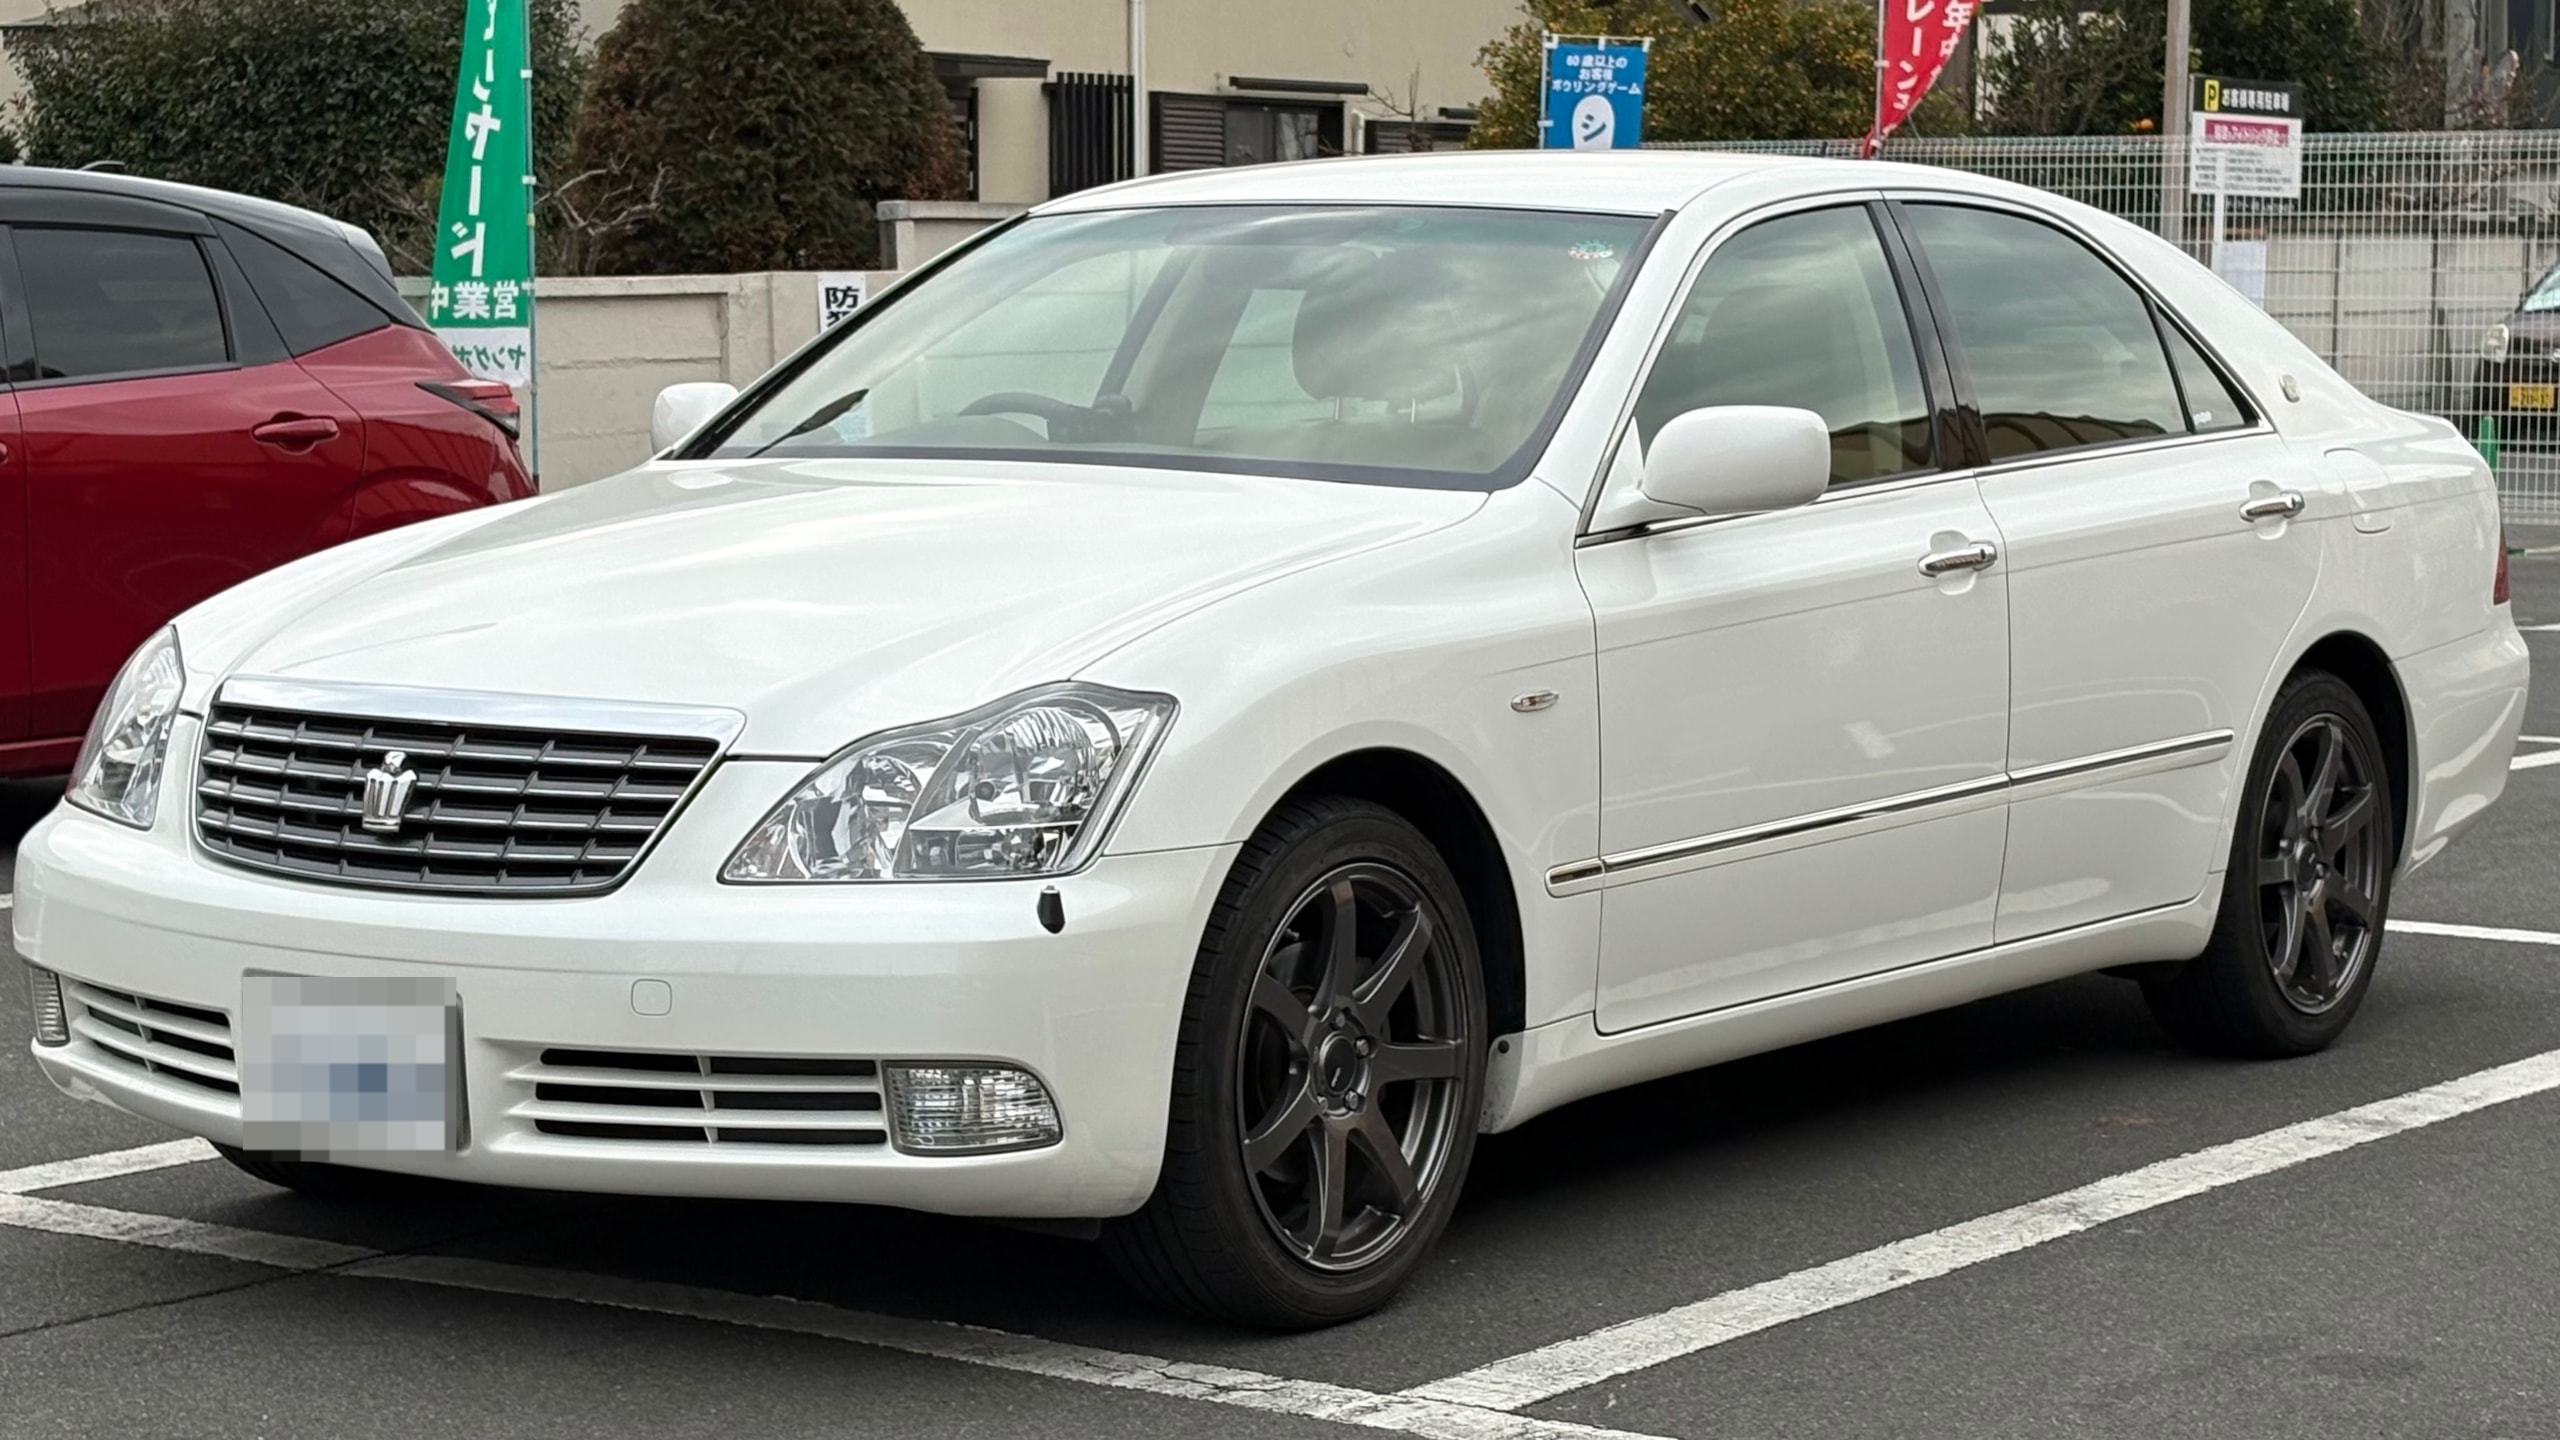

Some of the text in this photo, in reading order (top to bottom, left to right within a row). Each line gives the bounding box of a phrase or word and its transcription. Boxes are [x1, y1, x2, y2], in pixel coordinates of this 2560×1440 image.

[1578, 68, 1613, 81] お客様
[1552, 79, 1642, 95] ボウリングゲーム
[2208, 84, 2217, 109] P
[1581, 113, 1607, 142] シ
